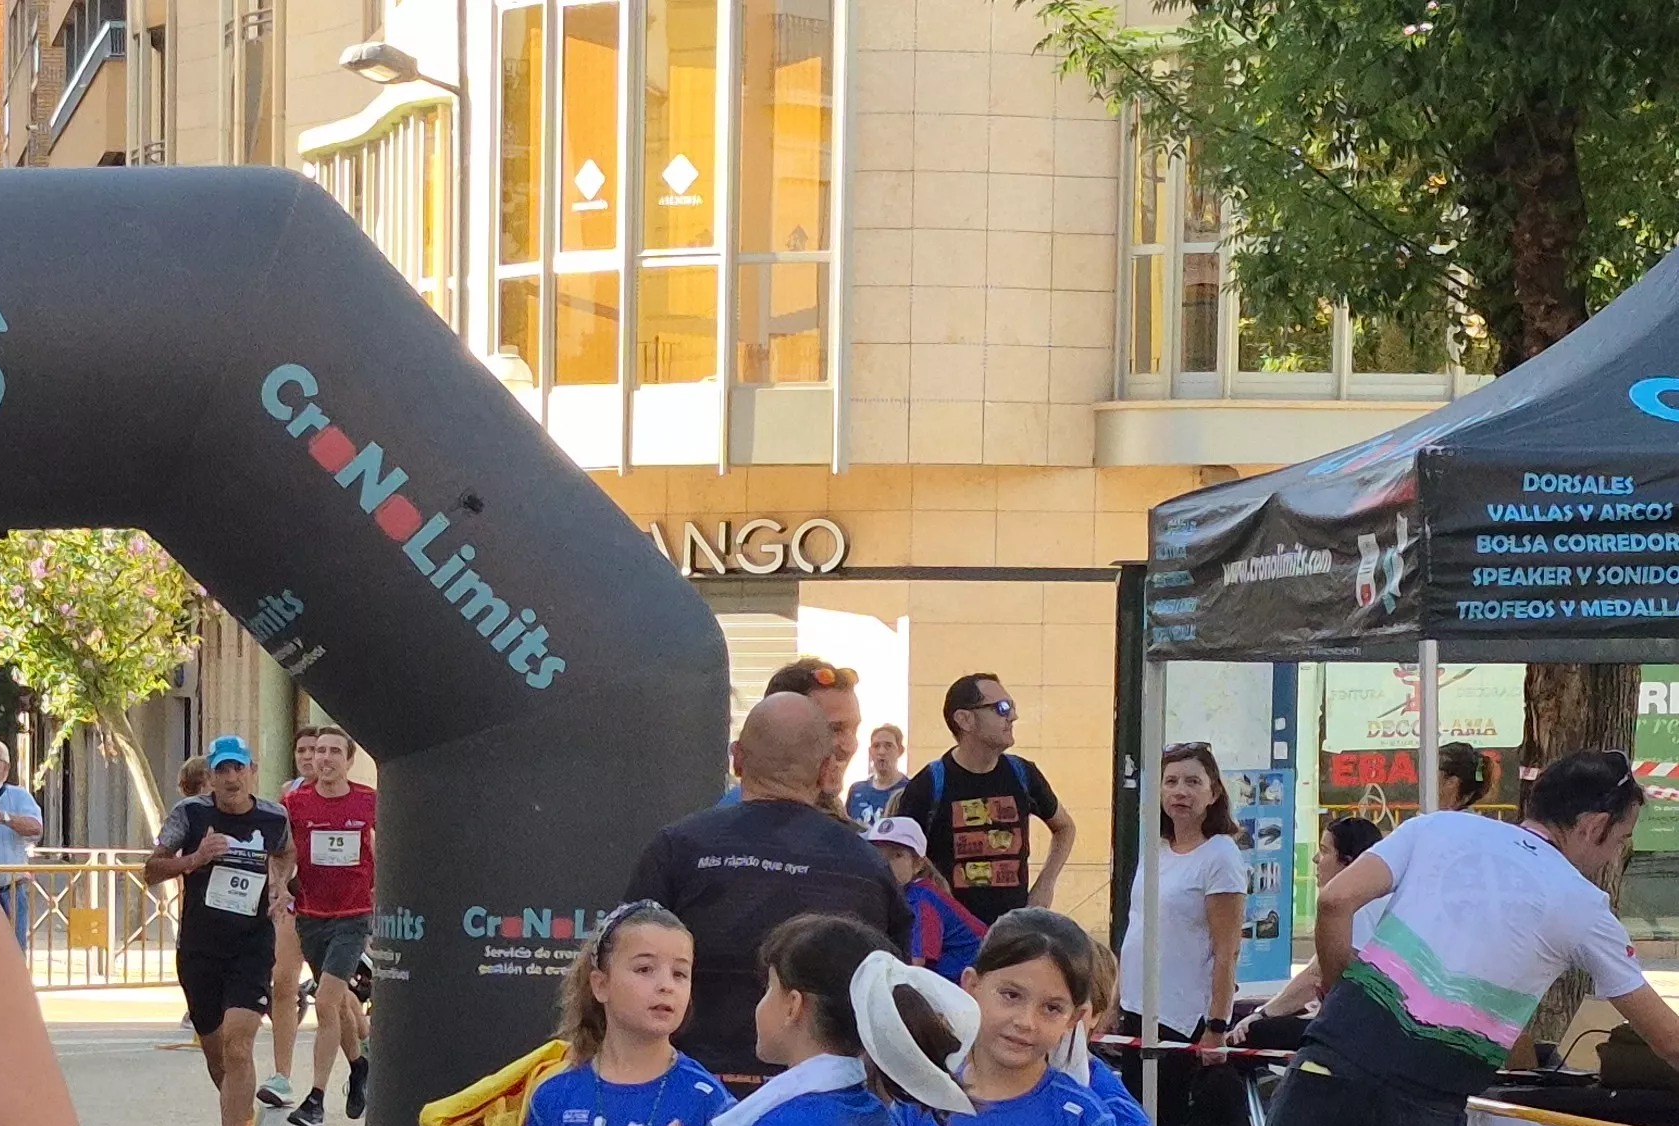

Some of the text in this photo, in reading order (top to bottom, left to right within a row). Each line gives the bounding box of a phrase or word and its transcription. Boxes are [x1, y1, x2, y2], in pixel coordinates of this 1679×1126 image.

[1523, 472, 1634, 495] DORSALES
[1487, 502, 1674, 523] VALLAS Y ARCOS
[1476, 534, 1548, 554] BOLSA
[1472, 566, 1572, 587] SPEAKER
[1577, 566, 1593, 586] Y
[1456, 600, 1556, 620] TROFEOS
[1559, 600, 1576, 618] Y
[761, 859, 783, 871] que
[230, 876, 250, 891] 60
[484, 946, 531, 959] Servicio
[535, 947, 551, 959] de
[526, 964, 542, 975] de
